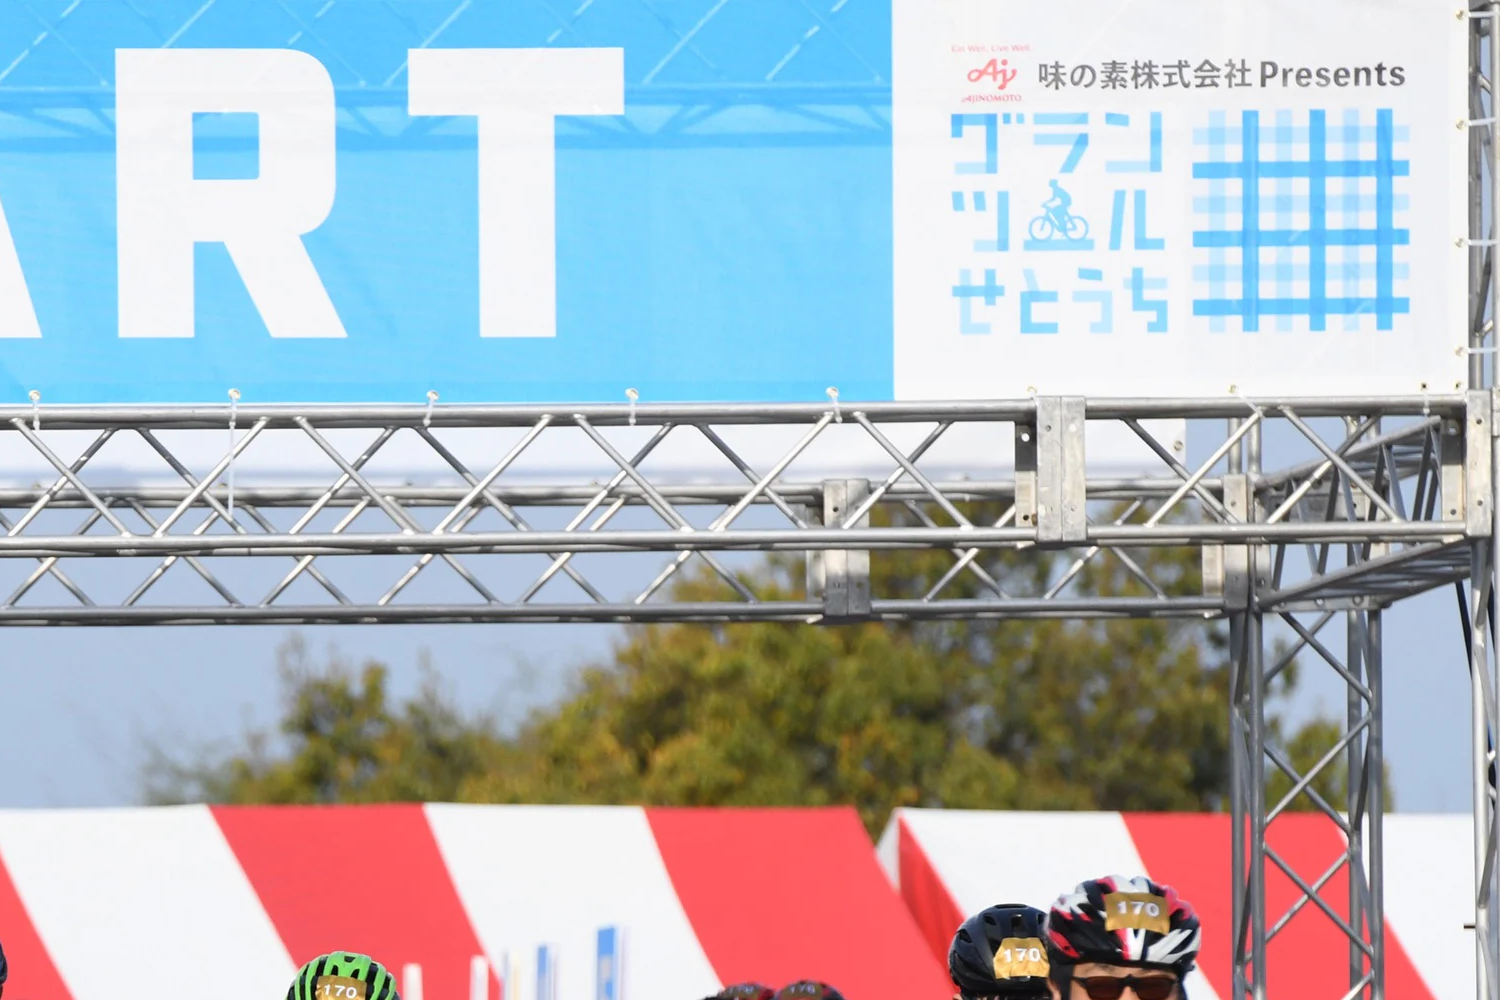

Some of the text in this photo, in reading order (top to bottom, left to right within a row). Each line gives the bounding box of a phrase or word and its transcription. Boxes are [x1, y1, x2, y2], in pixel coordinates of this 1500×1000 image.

[1038, 58, 1406, 90] 味の素株式会社 Presents
[961, 94, 1022, 103] AJINOMOTO
[950, 111, 1163, 174] グラン
[951, 266, 1169, 336] せとうち
[1115, 900, 1160, 918] 170
[1003, 947, 1041, 963] 170
[323, 983, 358, 1000] 170
